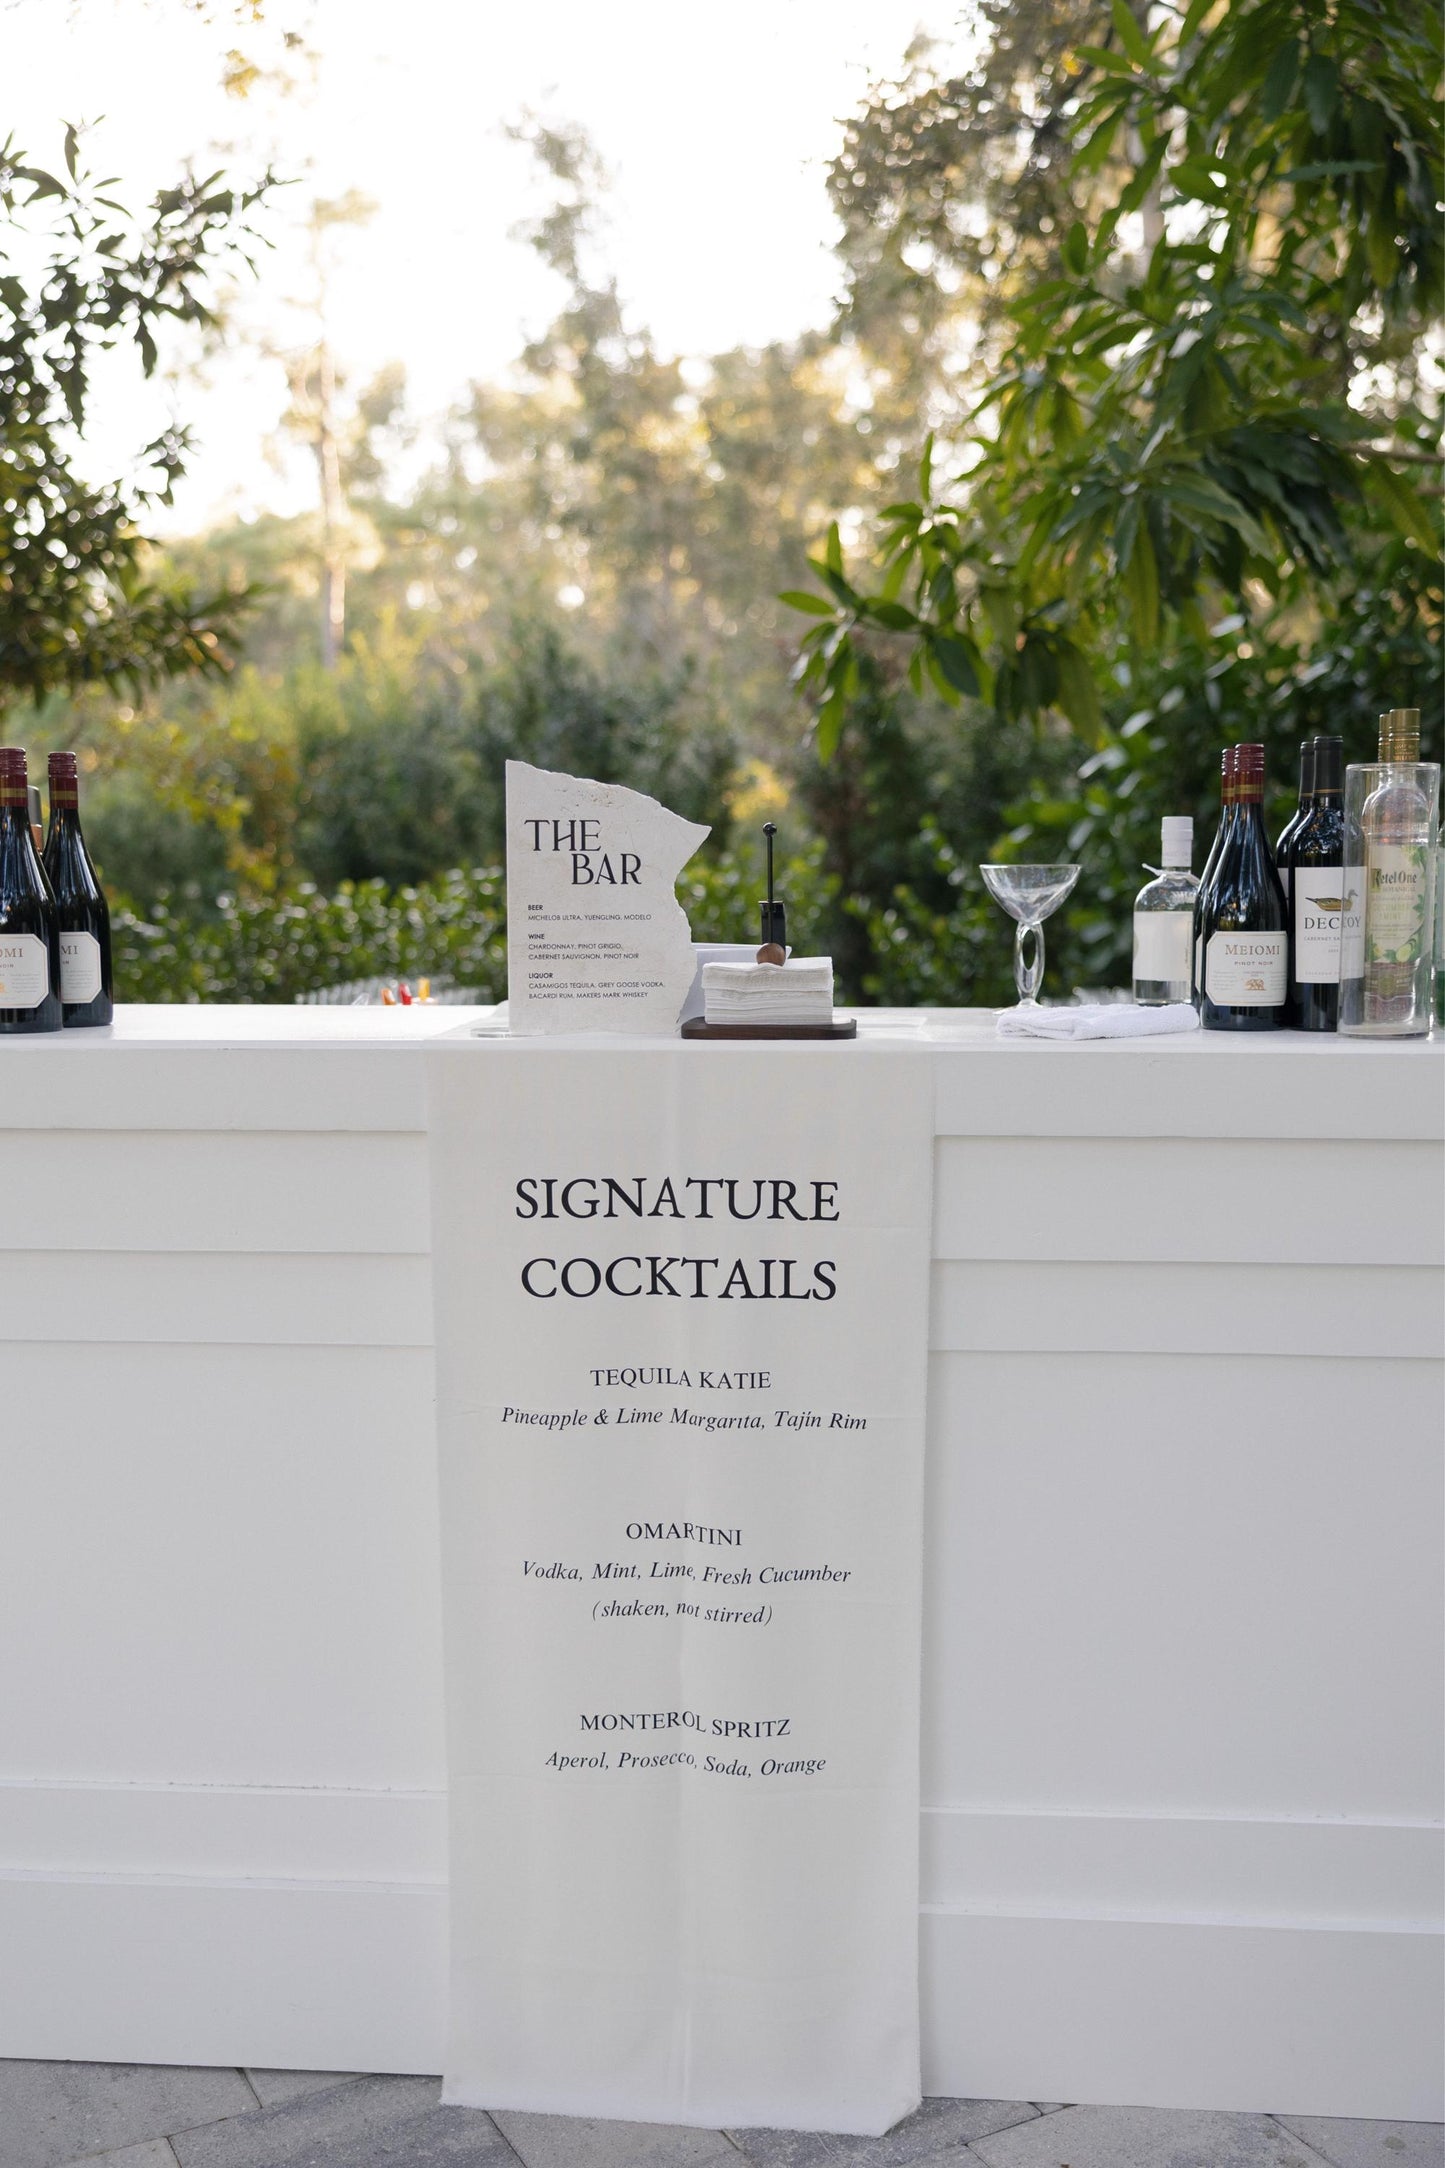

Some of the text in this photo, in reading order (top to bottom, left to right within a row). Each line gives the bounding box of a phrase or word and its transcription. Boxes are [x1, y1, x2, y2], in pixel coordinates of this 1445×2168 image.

[523, 819, 602, 852] THE
[570, 852, 643, 886] BAR
[1398, 870, 1417, 884] One
[1225, 944, 1281, 956] MEIOMI
[515, 1176, 840, 1222] SIGNATURE
[520, 1256, 837, 1301] COCKTAILS
[589, 1367, 772, 1390] TEQUILA KATIE
[501, 1406, 588, 1431] Pineapple
[593, 1408, 609, 1426] &
[615, 1407, 664, 1424] Lime
[774, 1410, 822, 1432] Tajín
[828, 1412, 867, 1430] Rim
[625, 1522, 742, 1546] OMARTINI
[523, 1560, 852, 1585] Vodka, Mint, Lime, Fresh Cucumber
[592, 1599, 773, 1626] (shaken, not stirred)
[579, 1710, 791, 1739] MONTEROL SPRITZ
[545, 1751, 827, 1779] Aperol, Prosecco, Soda, Orange
